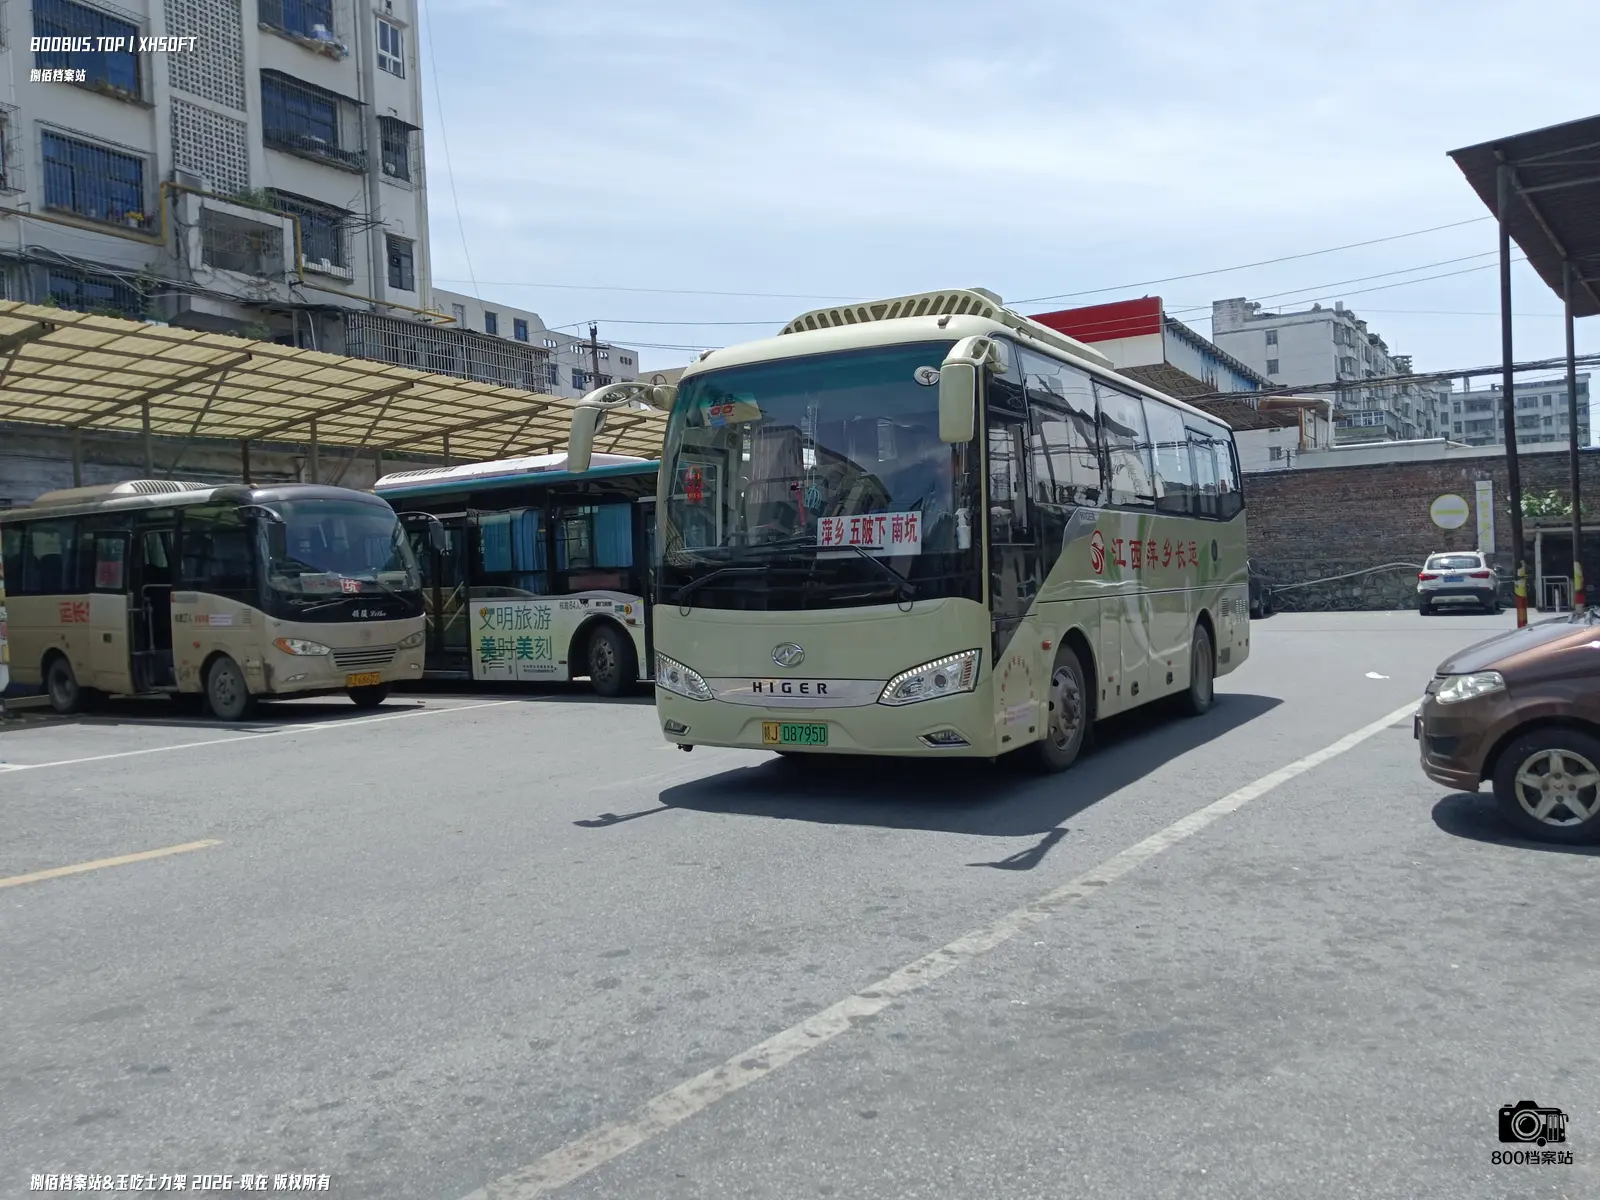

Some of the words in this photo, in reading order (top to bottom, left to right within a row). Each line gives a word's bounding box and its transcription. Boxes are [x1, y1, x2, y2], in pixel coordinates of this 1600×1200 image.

[821, 518, 844, 546] 萍乡
[849, 516, 887, 545] 五陂下
[891, 513, 918, 544] 南坑
[1111, 538, 1199, 570] 江西萍乡长运
[479, 605, 552, 631] 文明旅游
[480, 635, 553, 661] 美时美刻
[752, 681, 828, 695] HIGER
